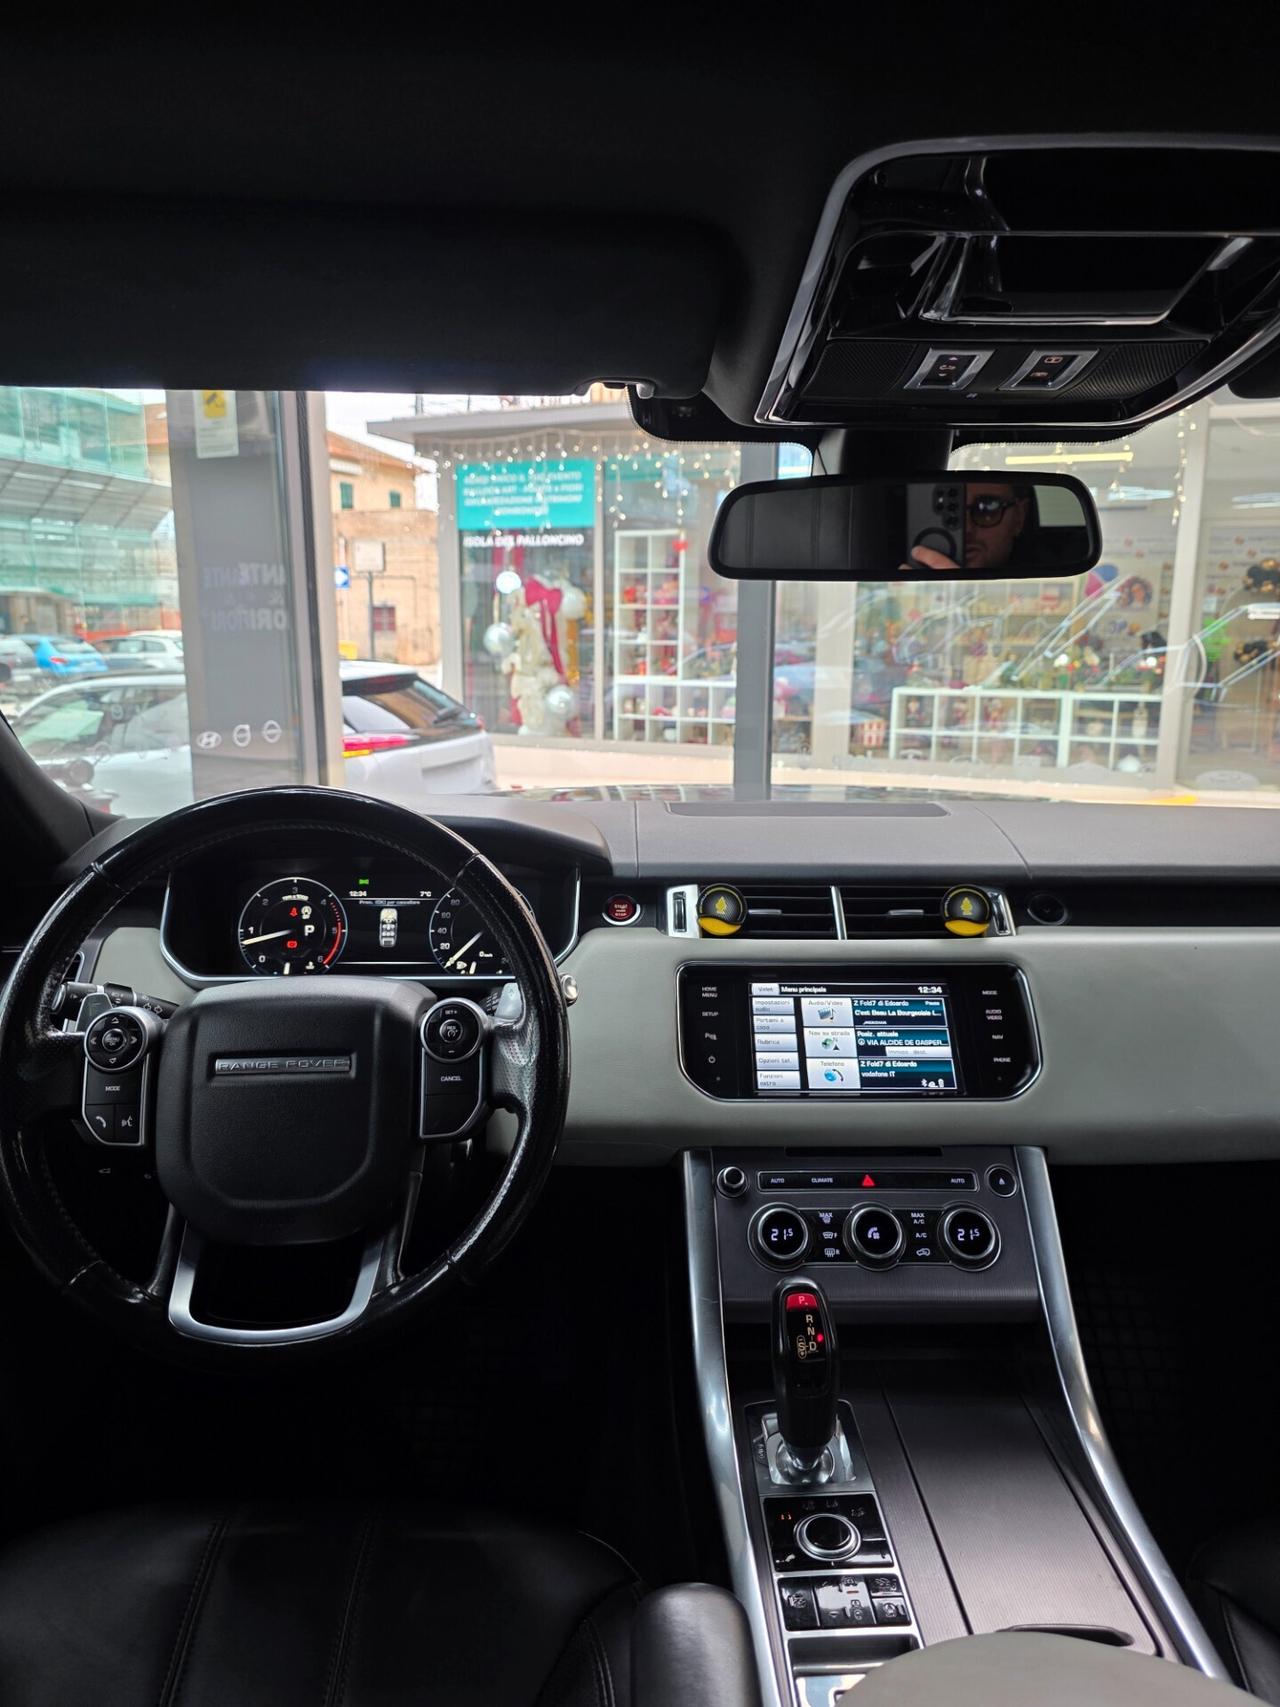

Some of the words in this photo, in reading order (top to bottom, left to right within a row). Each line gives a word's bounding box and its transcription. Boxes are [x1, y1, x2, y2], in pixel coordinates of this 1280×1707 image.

[516, 533, 585, 547] PALLONCINO
[304, 924, 315, 936] P
[439, 942, 451, 950] 20
[917, 985, 943, 994] 12:34
[217, 1060, 279, 1071] RANGE
[285, 1058, 350, 1069] ROVER
[798, 1295, 805, 1305] P
[805, 1313, 814, 1323] R
[807, 1327, 815, 1336] N
[809, 1341, 817, 1351] D
